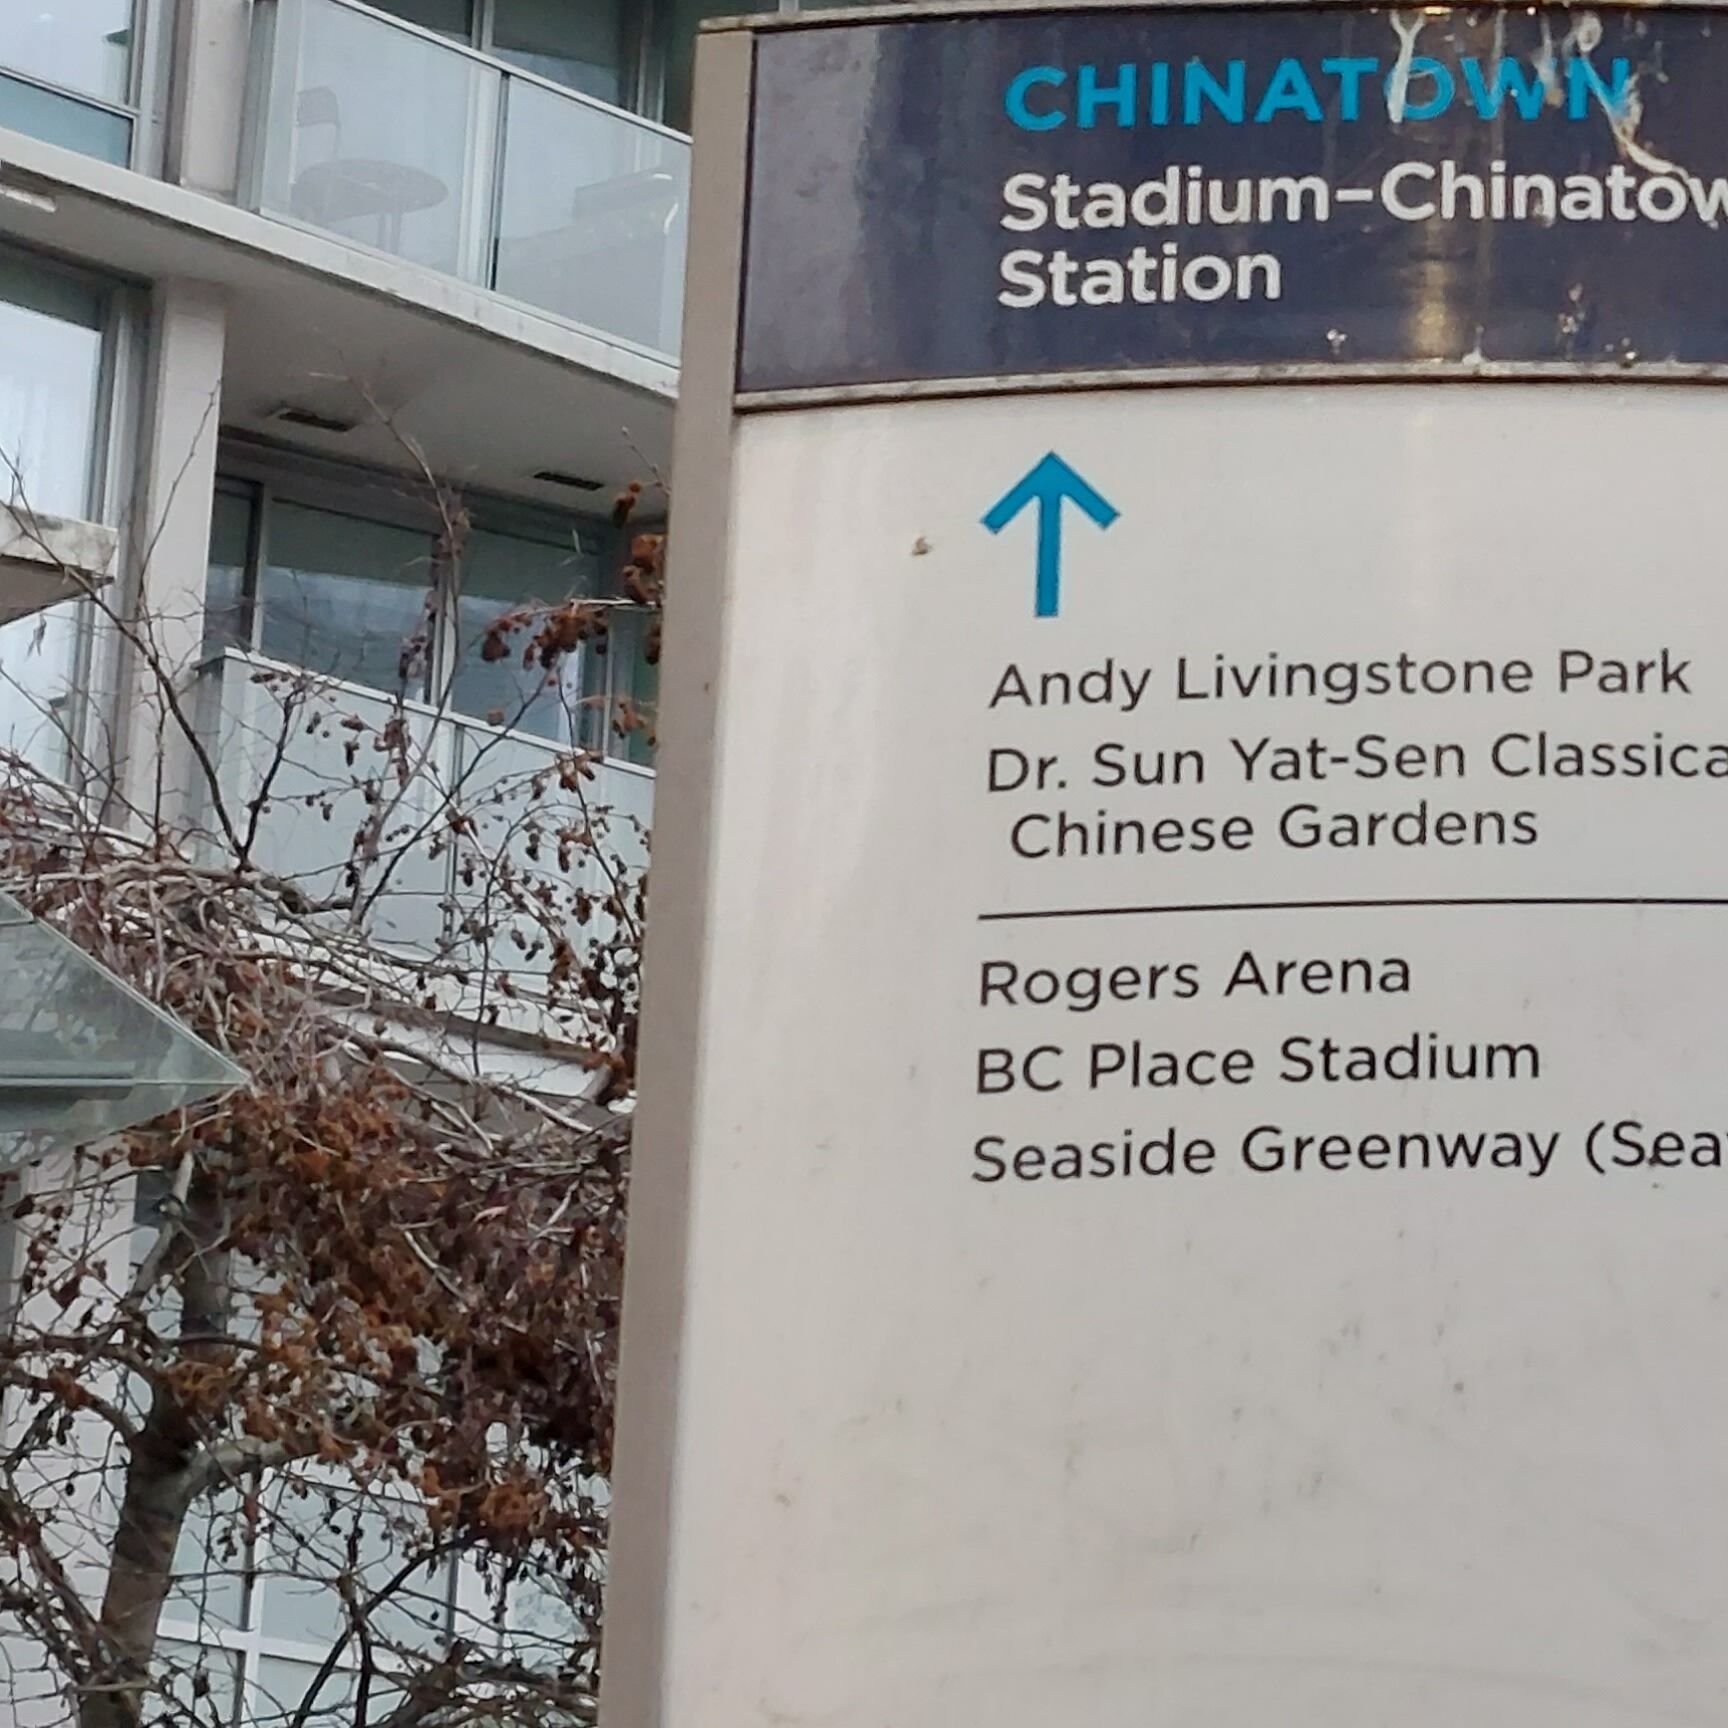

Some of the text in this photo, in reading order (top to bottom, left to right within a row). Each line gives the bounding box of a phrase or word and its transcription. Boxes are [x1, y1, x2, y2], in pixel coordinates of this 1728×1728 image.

[1003, 56, 1633, 132] CHINATOWN
[998, 242, 1281, 308] Station
[988, 647, 1692, 712] Andy Livingstone Park
[987, 748, 1067, 793] Dr.
[1092, 742, 1204, 787] Sun
[1230, 734, 1465, 782] Yat-Sen
[1010, 800, 1539, 859] Chinese Gardens
[980, 951, 1410, 1013] Rogers Arena
[977, 1032, 1540, 1094] BC Place Stadium
[971, 1127, 1216, 1183] Seaside
[1241, 1124, 1560, 1178] Greenway
